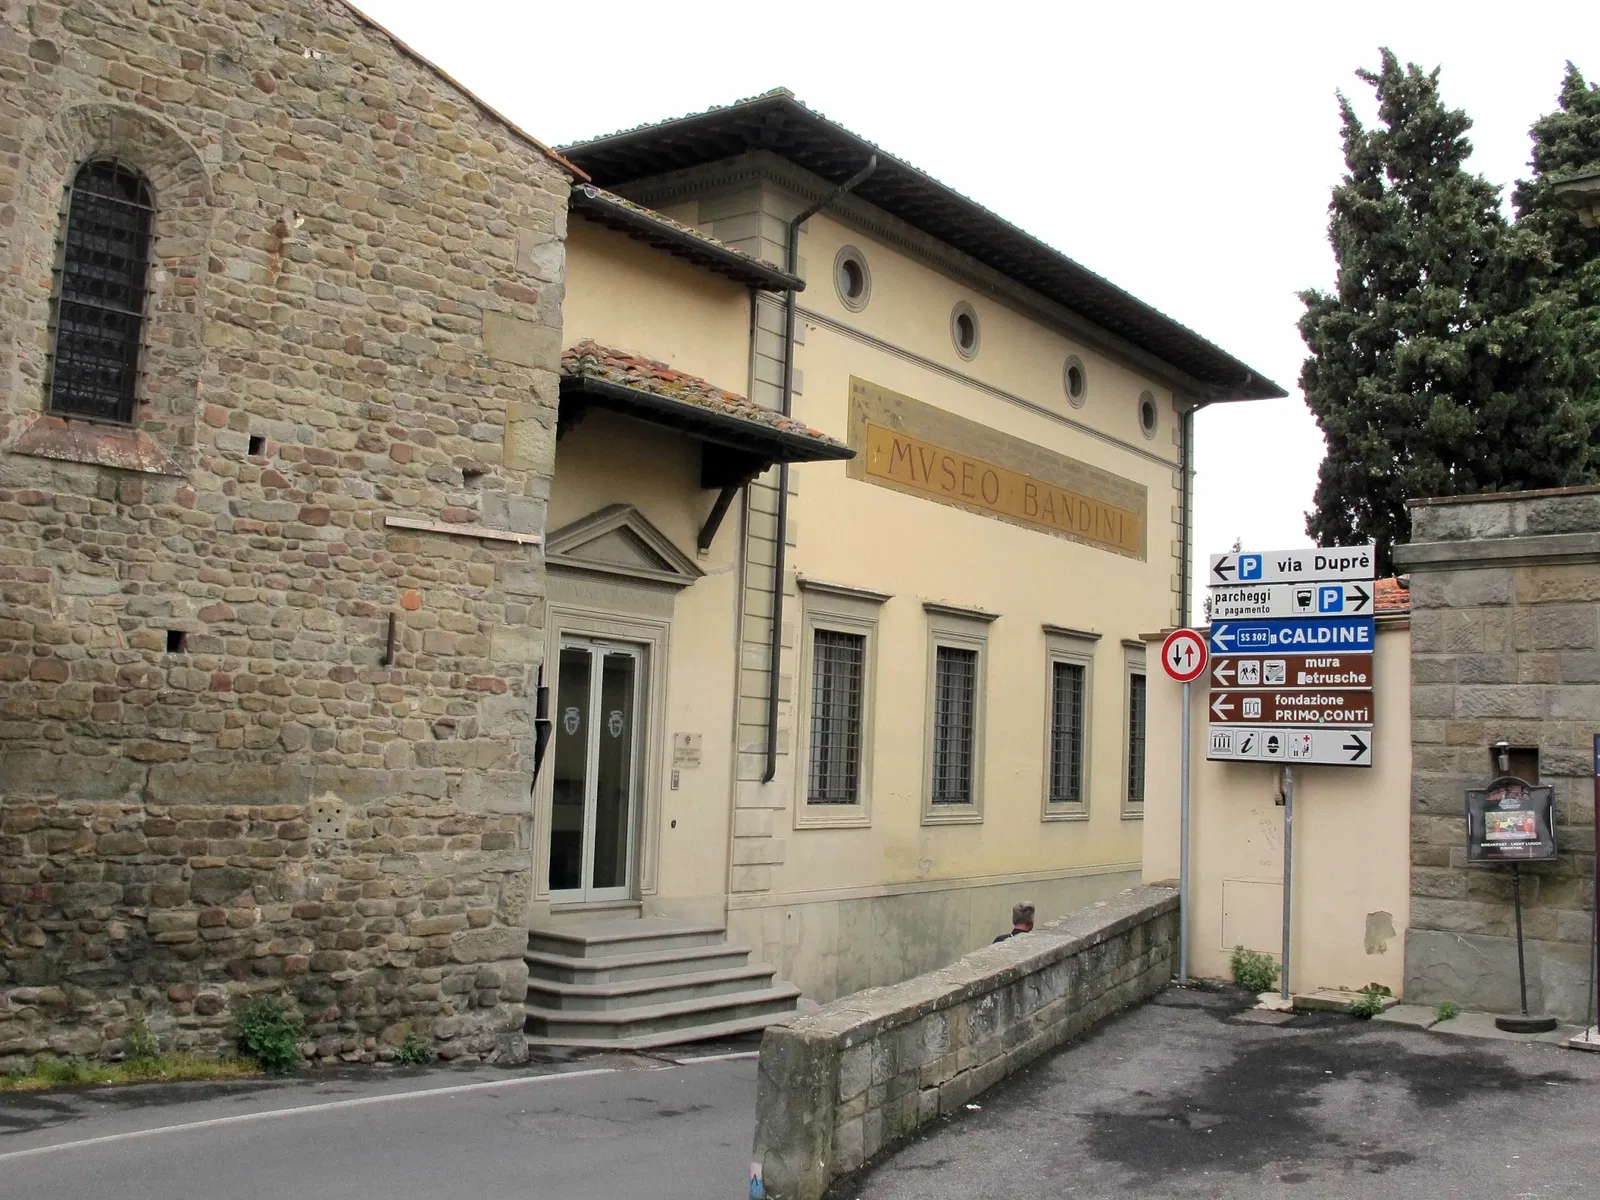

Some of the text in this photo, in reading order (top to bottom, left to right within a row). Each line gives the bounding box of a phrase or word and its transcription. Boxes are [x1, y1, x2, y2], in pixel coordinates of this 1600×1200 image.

[1023, 483, 1124, 544] BANDINI
[1243, 552, 1370, 577] P via Duprè
[1215, 588, 1338, 609] parcheggi P
[1225, 606, 1271, 616] pagamento
[1240, 626, 1369, 644] SS 302 CALDINE
[1305, 657, 1340, 668] mura
[1305, 671, 1367, 684] etrusche
[1275, 694, 1344, 705] fondazione
[1275, 710, 1320, 721] PRIMO
